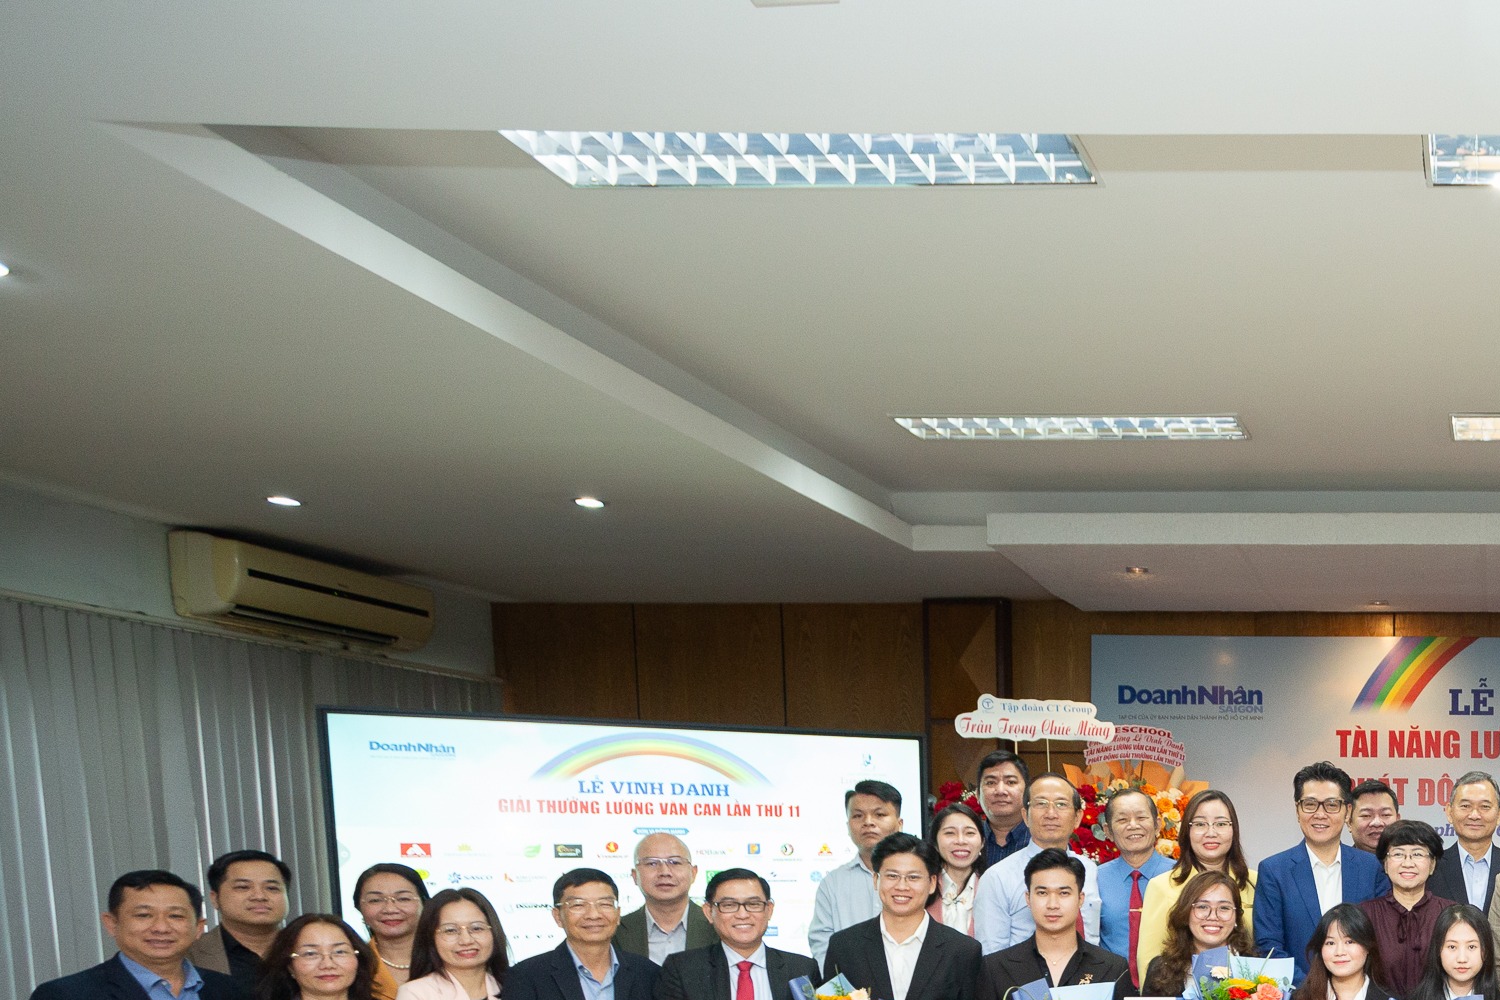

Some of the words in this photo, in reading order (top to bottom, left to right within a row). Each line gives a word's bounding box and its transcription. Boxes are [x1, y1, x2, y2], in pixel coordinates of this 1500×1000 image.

[1118, 685, 1263, 705] DoanhNhân
[1448, 678, 1494, 716] LỄ
[1001, 702, 1019, 713] Tập
[1021, 702, 1044, 712] đoàn
[1046, 703, 1062, 713] CT
[1063, 704, 1093, 715] Group
[1219, 705, 1263, 714] SAIGON
[997, 717, 1036, 738] Trọng
[1041, 718, 1071, 736] Chúc
[1074, 720, 1111, 739] Mừng
[369, 741, 456, 754] DoanhNhân
[1336, 725, 1378, 758] TÀI
[1388, 725, 1461, 759] NĂNG
[610, 780, 664, 796] VINH
[671, 782, 730, 797] DANH
[606, 799, 654, 816] LƯƠNG
[693, 803, 722, 817] CAN
[788, 805, 801, 818] 11
